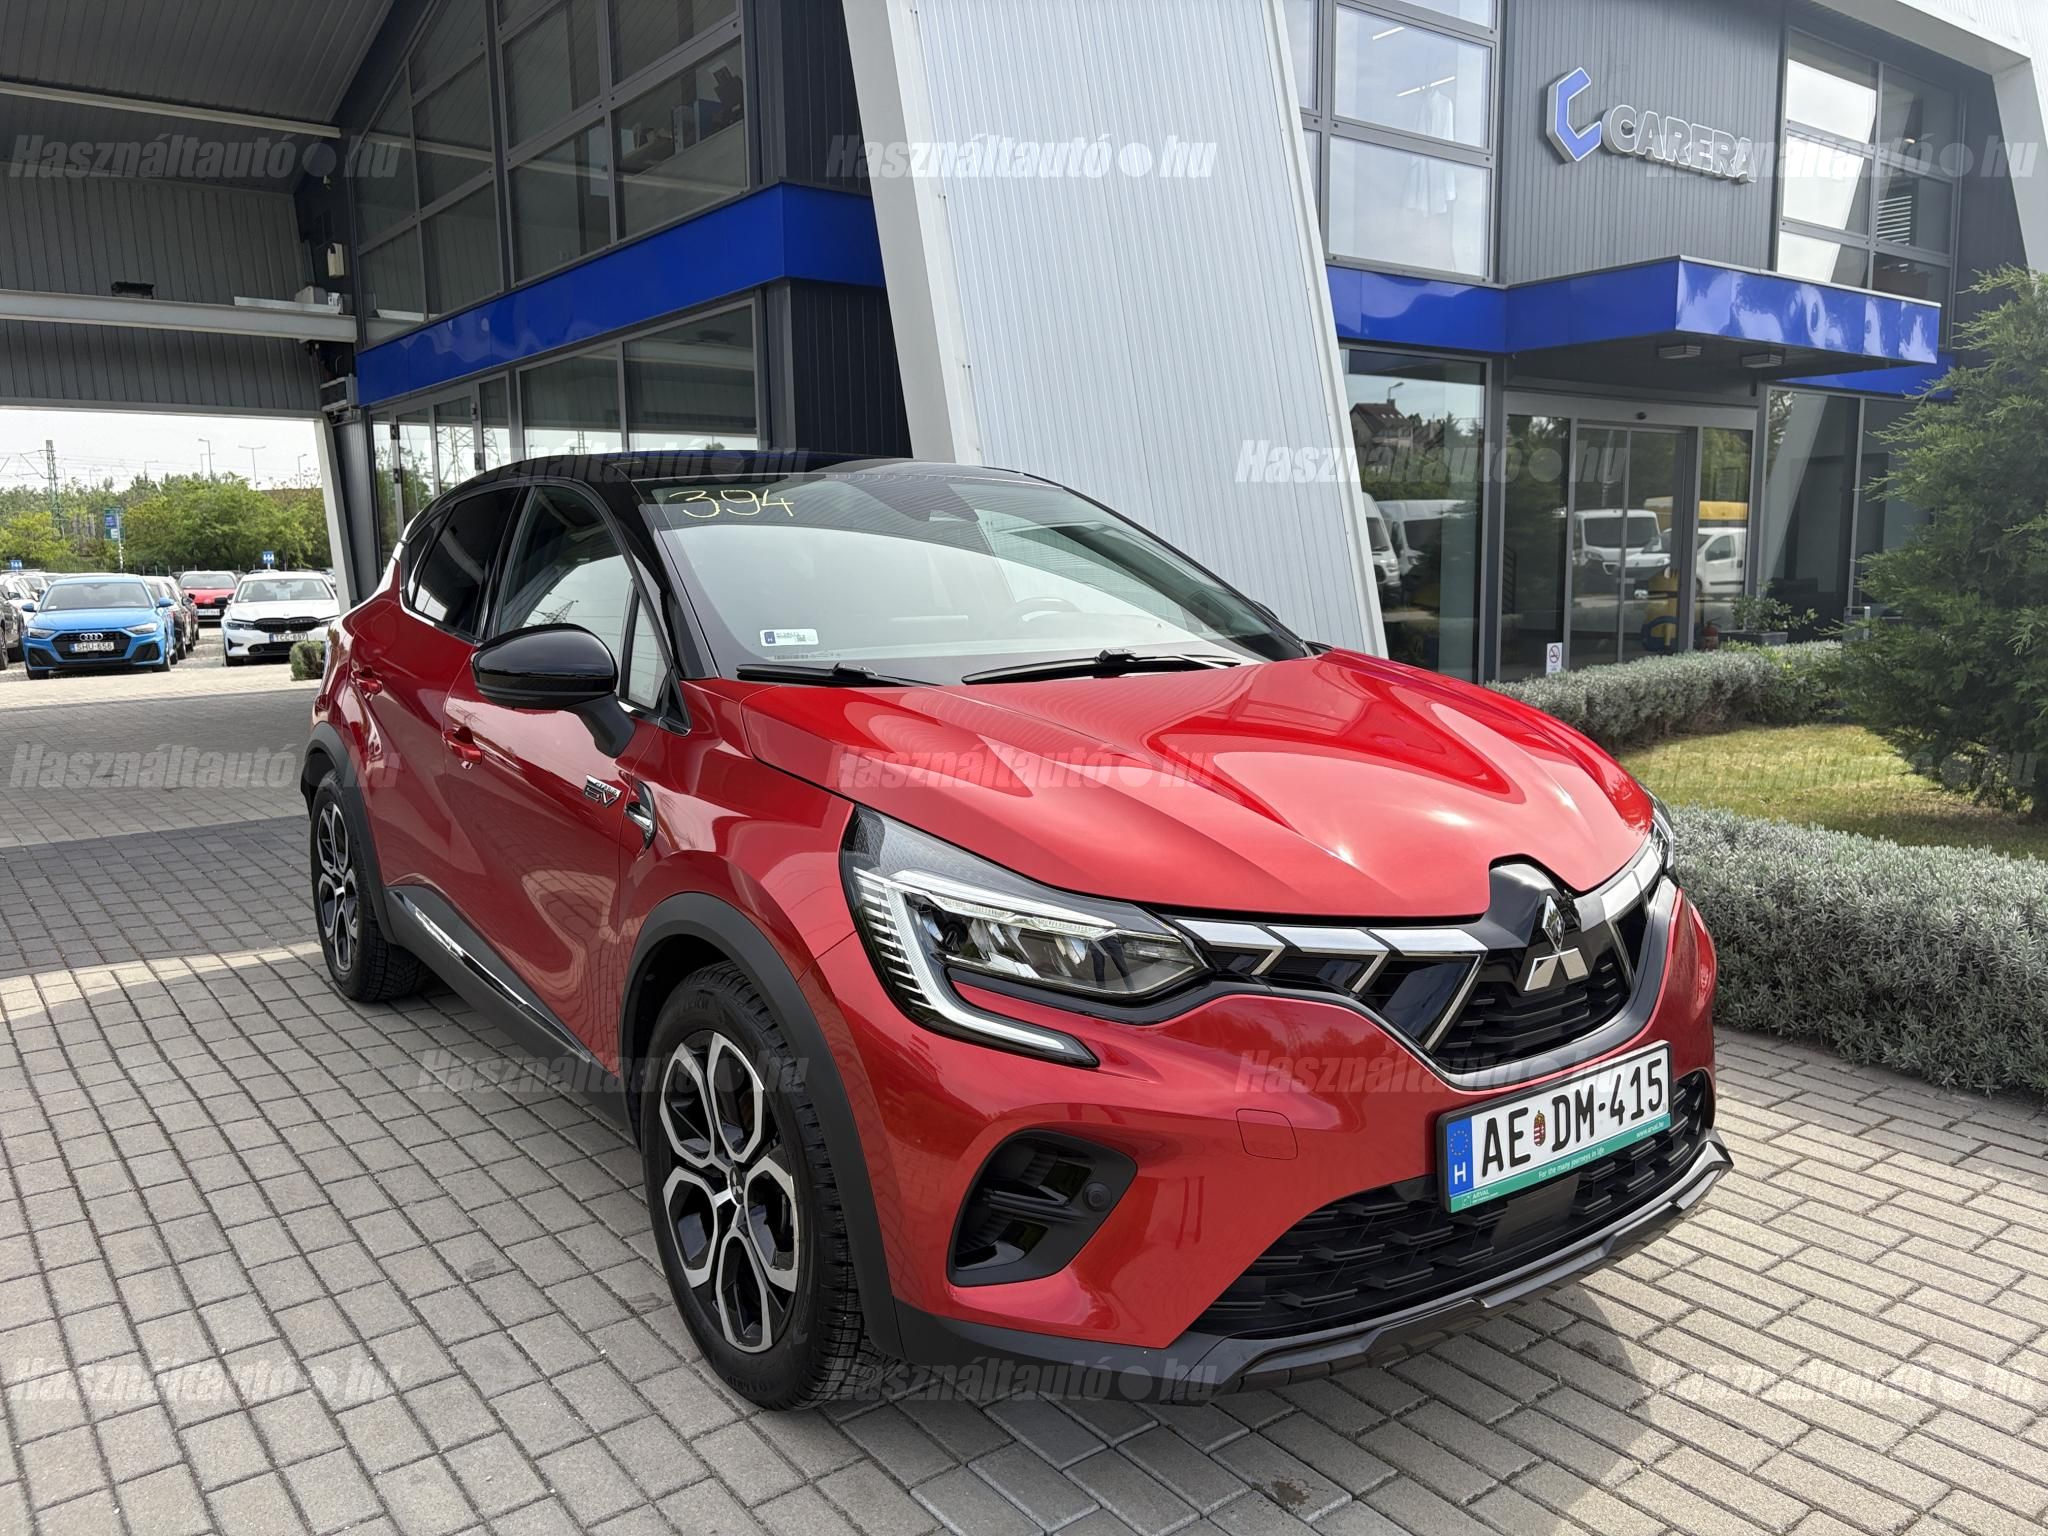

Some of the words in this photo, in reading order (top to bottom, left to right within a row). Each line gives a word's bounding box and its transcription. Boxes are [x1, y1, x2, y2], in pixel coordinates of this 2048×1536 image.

[1606, 104, 1757, 182] CARERA
[669, 488, 794, 518] 394
[1482, 1107, 1531, 1178] AE
[1552, 1058, 1663, 1152] DM-415
[1454, 1162, 1466, 1184] H
[1539, 1170, 1547, 1178] For
[1548, 1166, 1556, 1175] the
[1472, 1189, 1489, 1199] ARVAL
